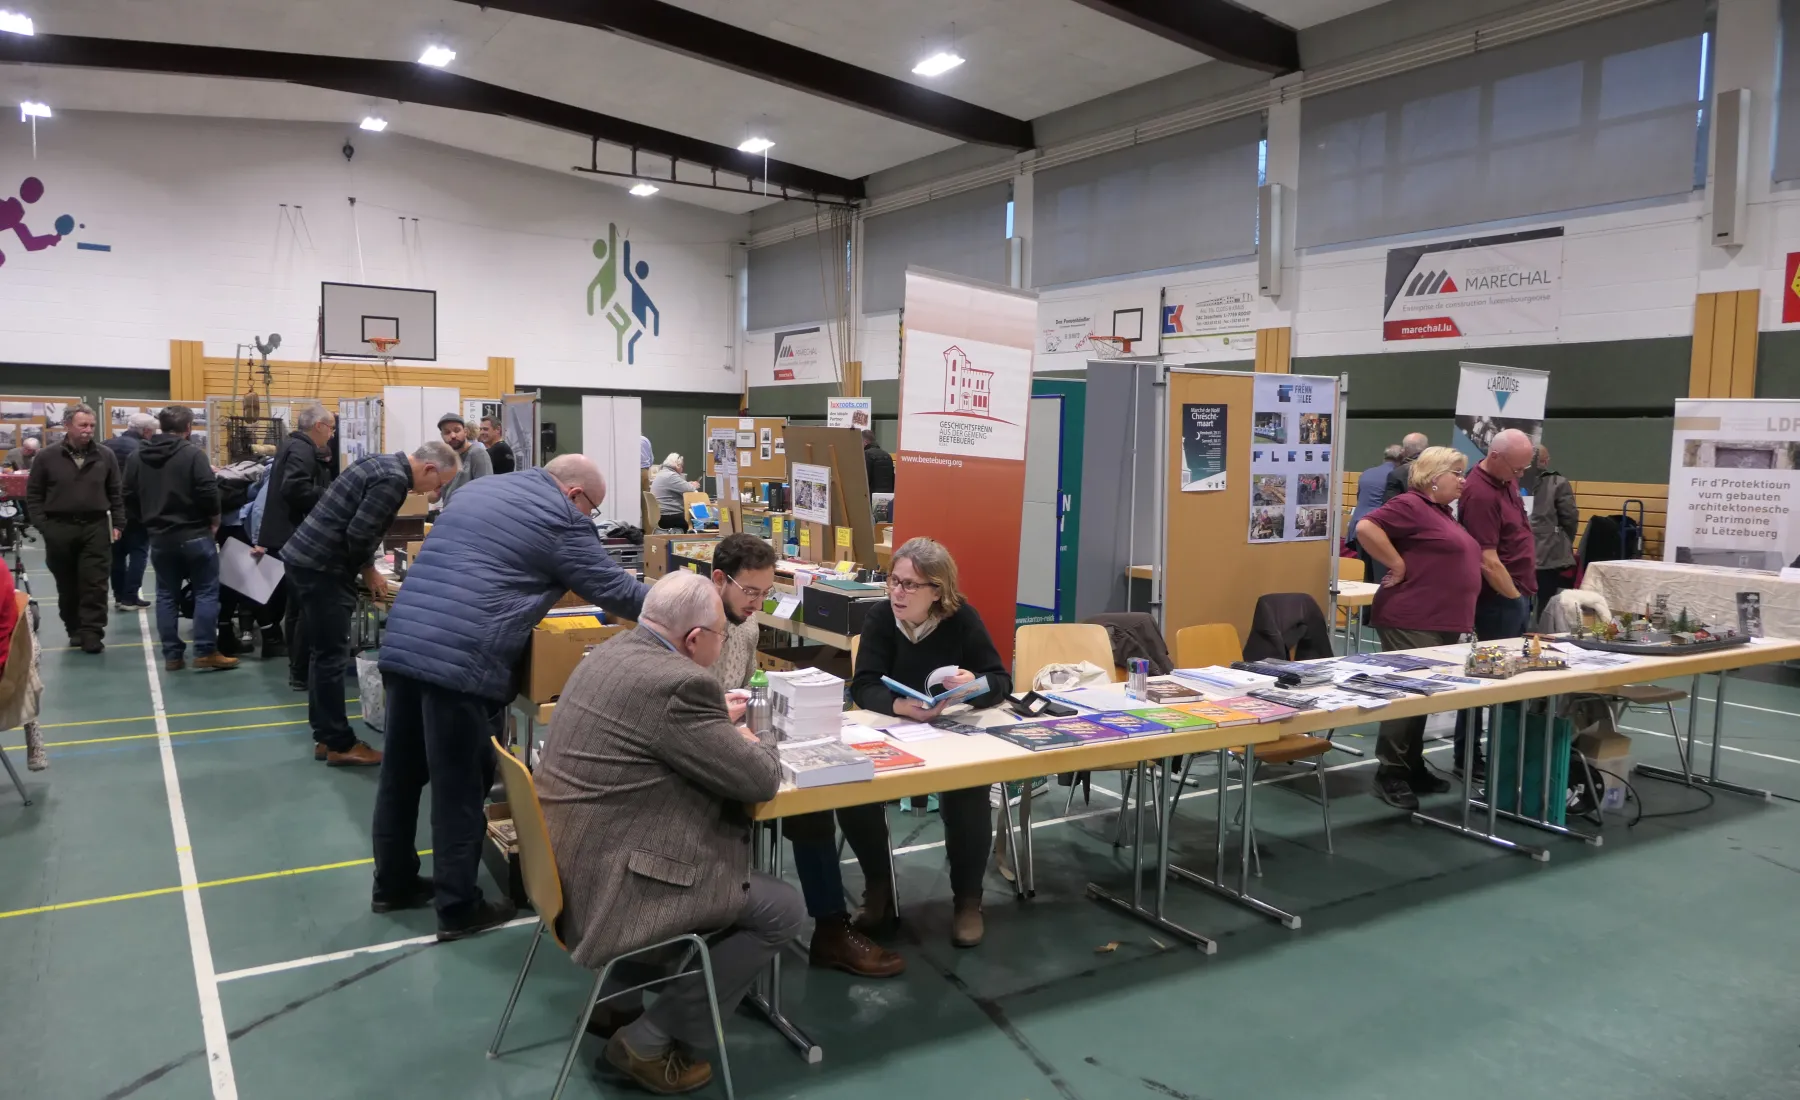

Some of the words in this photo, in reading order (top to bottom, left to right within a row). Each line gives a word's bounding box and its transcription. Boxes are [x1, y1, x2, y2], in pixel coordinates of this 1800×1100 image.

[1465, 270, 1551, 291] MARECHAL
[1445, 300, 1487, 309] construction
[1489, 294, 1551, 305] luxembourgeoise
[1401, 323, 1452, 334] marechal.lu
[1487, 376, 1520, 392] L'ARDOISE
[1302, 395, 1312, 403] LEE
[1191, 412, 1219, 420] Chrëscht-
[939, 421, 993, 433] GESCHICHTSFRËNN
[939, 429, 951, 437] AUS
[952, 429, 963, 437] DER
[964, 430, 987, 440] GEMENG
[939, 435, 975, 445] BEETEBUERG
[901, 455, 962, 468] www.beetebuerg.org
[1691, 478, 1707, 487] Fir
[1698, 491, 1722, 499] vum
[1726, 491, 1781, 501] gebauten
[1688, 502, 1790, 514] architektonesche
[1705, 514, 1770, 525] Patrimoine
[1712, 526, 1778, 540] Lëtzebuerg
